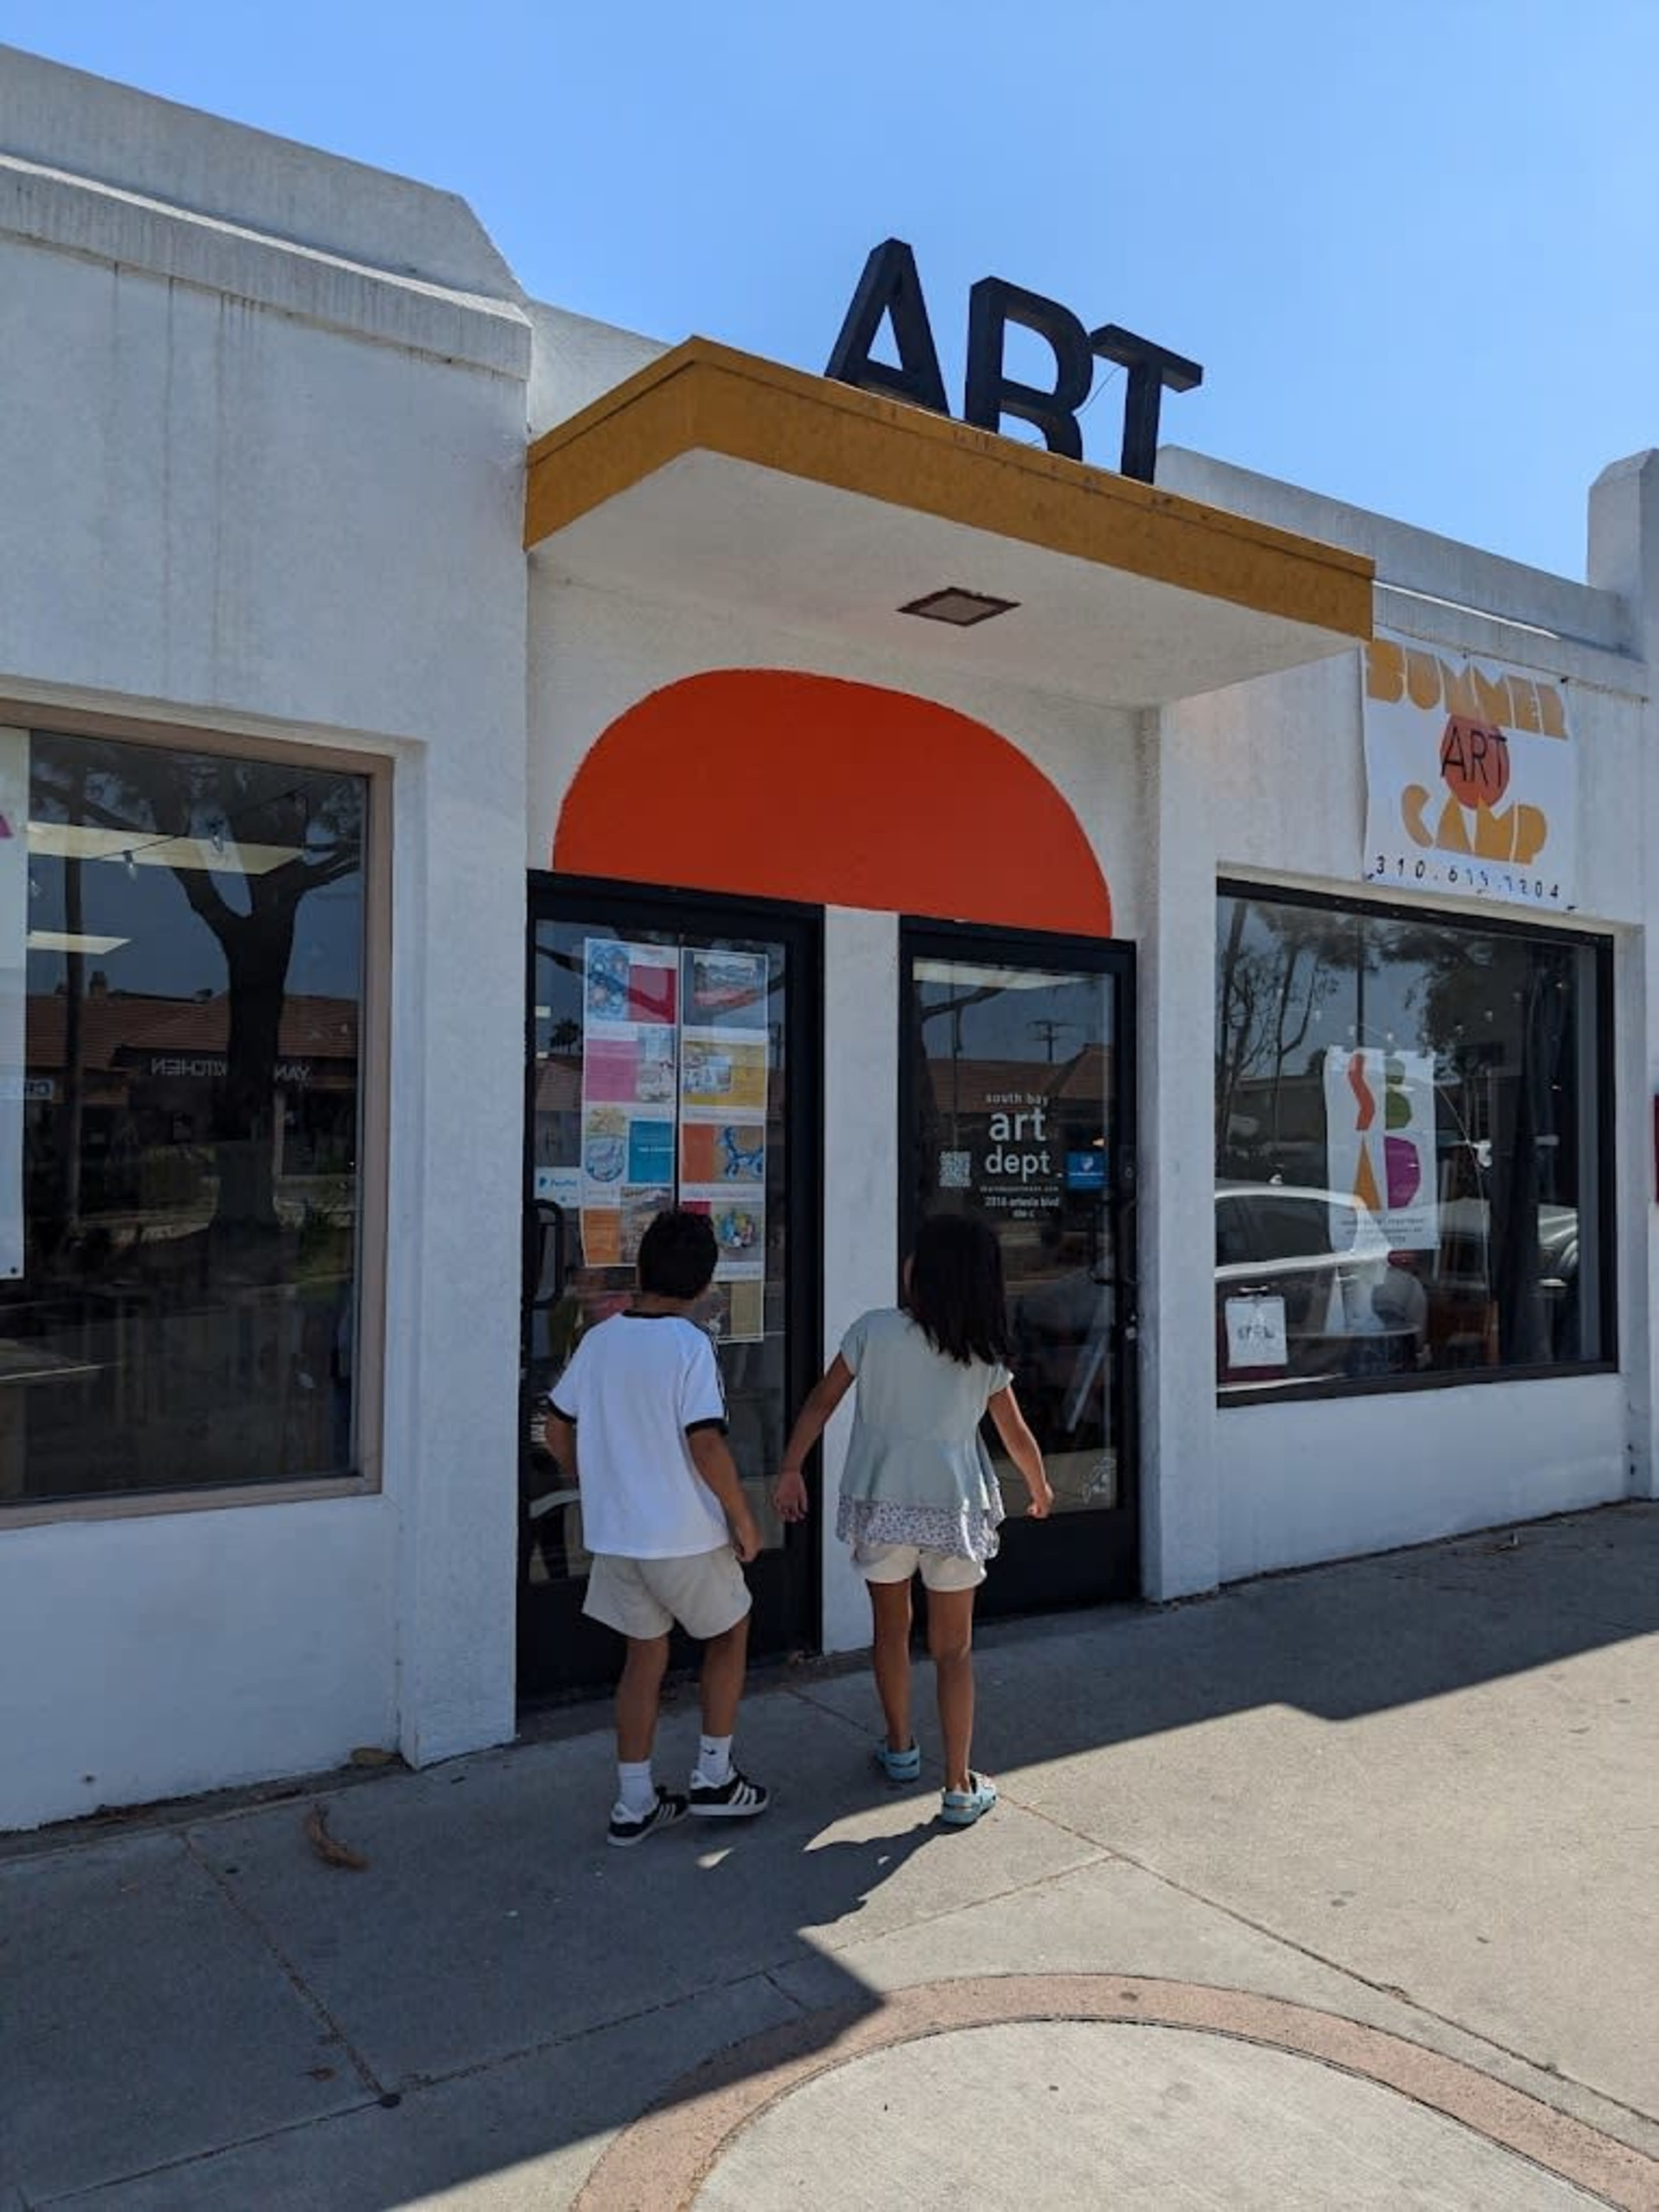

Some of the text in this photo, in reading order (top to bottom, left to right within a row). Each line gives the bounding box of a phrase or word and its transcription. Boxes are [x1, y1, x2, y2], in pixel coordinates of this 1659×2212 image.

[824, 238, 1203, 484] ART
[1440, 726, 1508, 788] ART
[1401, 784, 1547, 865] CAMP
[986, 1093, 1049, 1106] south bay
[989, 1107, 1046, 1141] art
